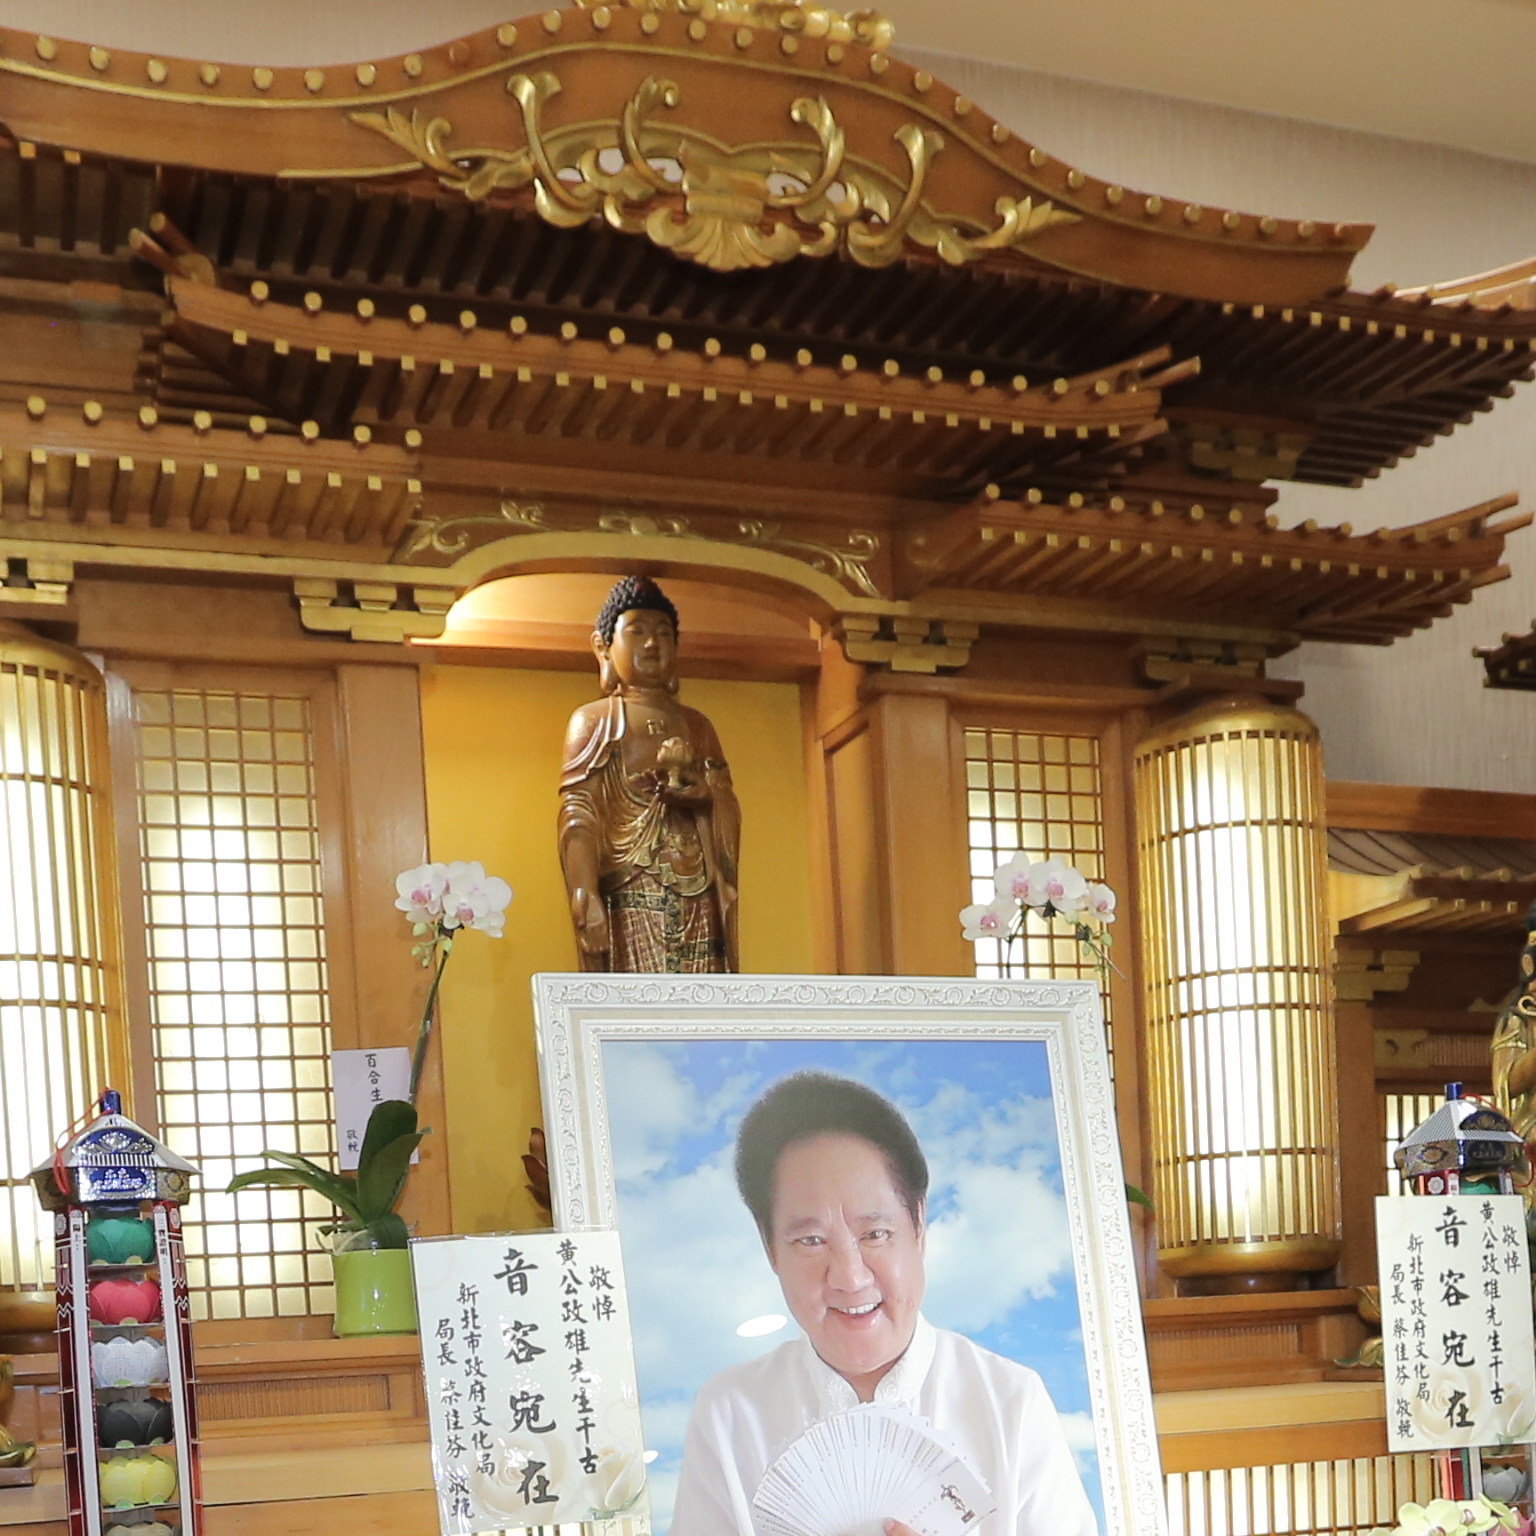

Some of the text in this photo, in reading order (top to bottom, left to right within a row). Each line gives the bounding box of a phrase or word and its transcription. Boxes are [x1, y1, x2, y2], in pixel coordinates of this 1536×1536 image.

[588, 1264, 617, 1321] 敬悼
[1390, 1264, 1407, 1306] 局長
[1501, 1224, 1522, 1274] 敬悼
[434, 1318, 457, 1366] 局長
[1407, 1233, 1431, 1402] 新北市政府文化局
[1435, 1205, 1476, 1429] 音容宛在
[456, 1282, 496, 1476] 新北市政府文化局
[493, 1248, 559, 1505] 音容宛在
